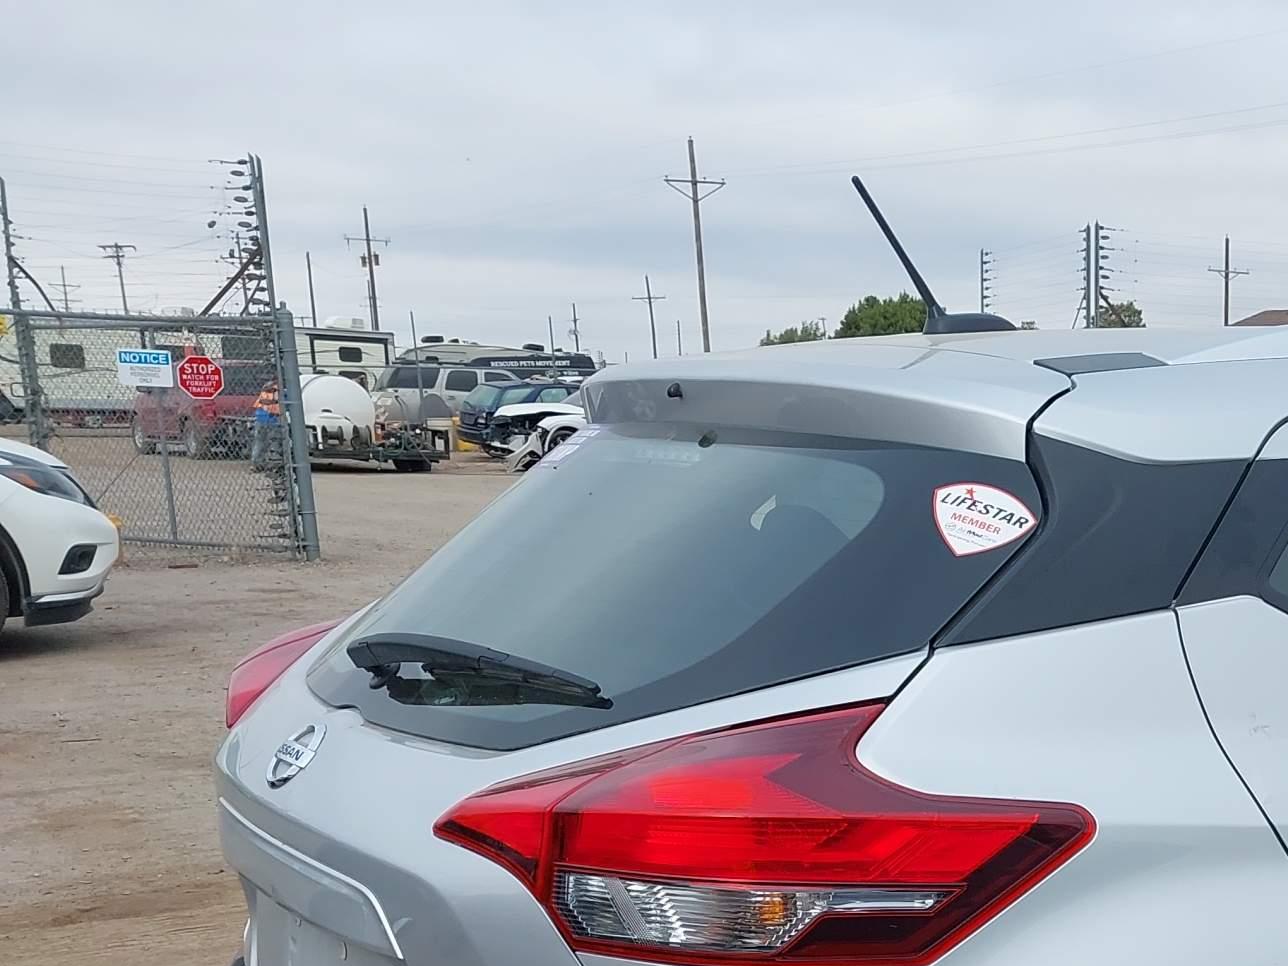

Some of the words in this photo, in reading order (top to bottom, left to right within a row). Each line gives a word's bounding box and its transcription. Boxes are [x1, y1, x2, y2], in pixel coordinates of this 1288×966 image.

[121, 352, 167, 364] NOTICE
[184, 363, 215, 374] STOP
[940, 491, 1029, 529] LIFESTAR
[950, 511, 1002, 535] MEMBER
